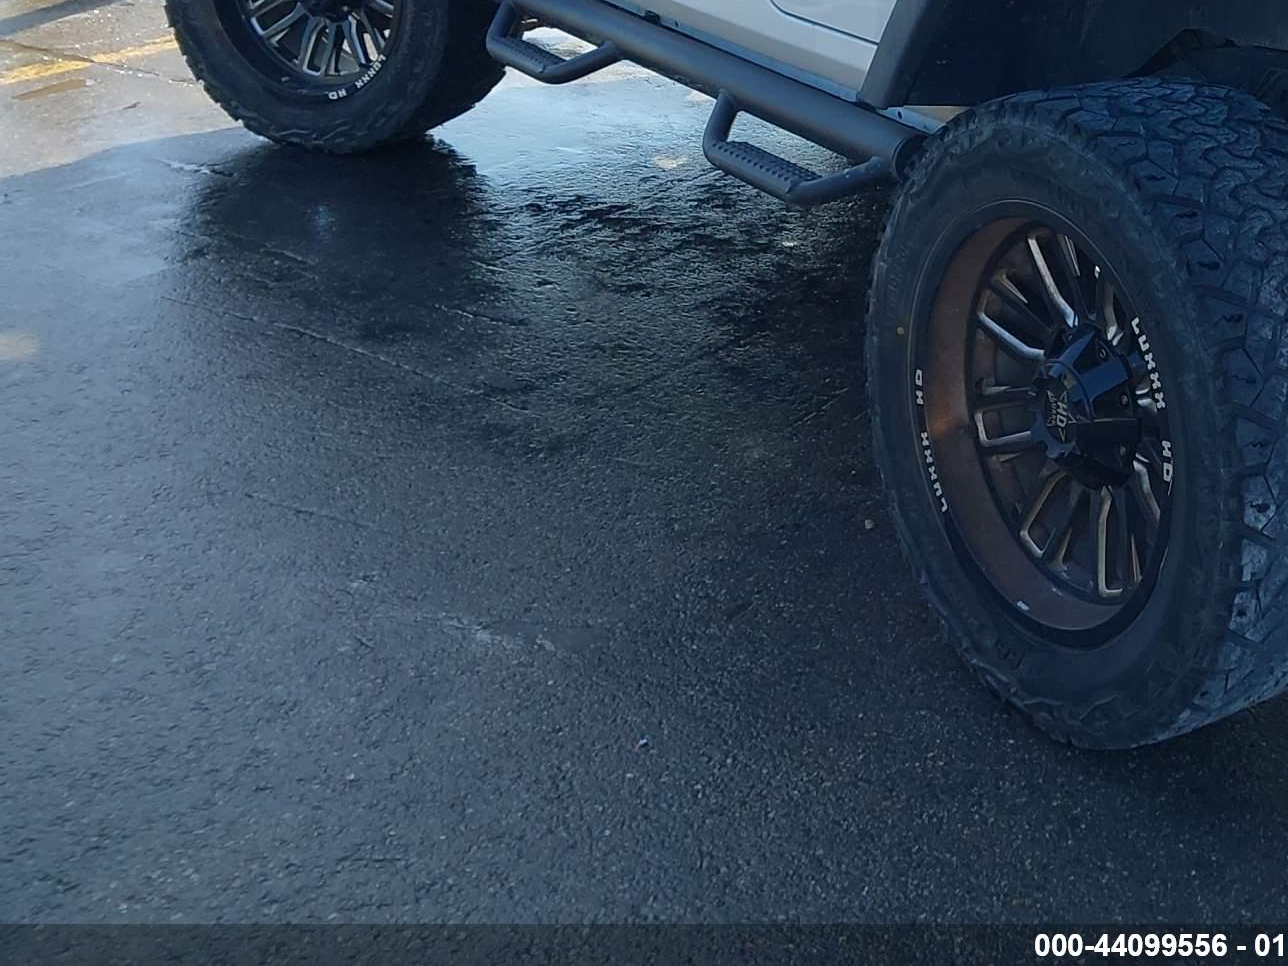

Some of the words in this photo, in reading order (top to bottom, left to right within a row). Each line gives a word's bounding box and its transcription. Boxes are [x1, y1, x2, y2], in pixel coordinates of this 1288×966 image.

[328, 89, 348, 100] HD
[915, 369, 924, 405] HD
[1131, 316, 1166, 409] LUXXX
[1161, 440, 1174, 483] HD
[920, 431, 949, 513] LUXXX
